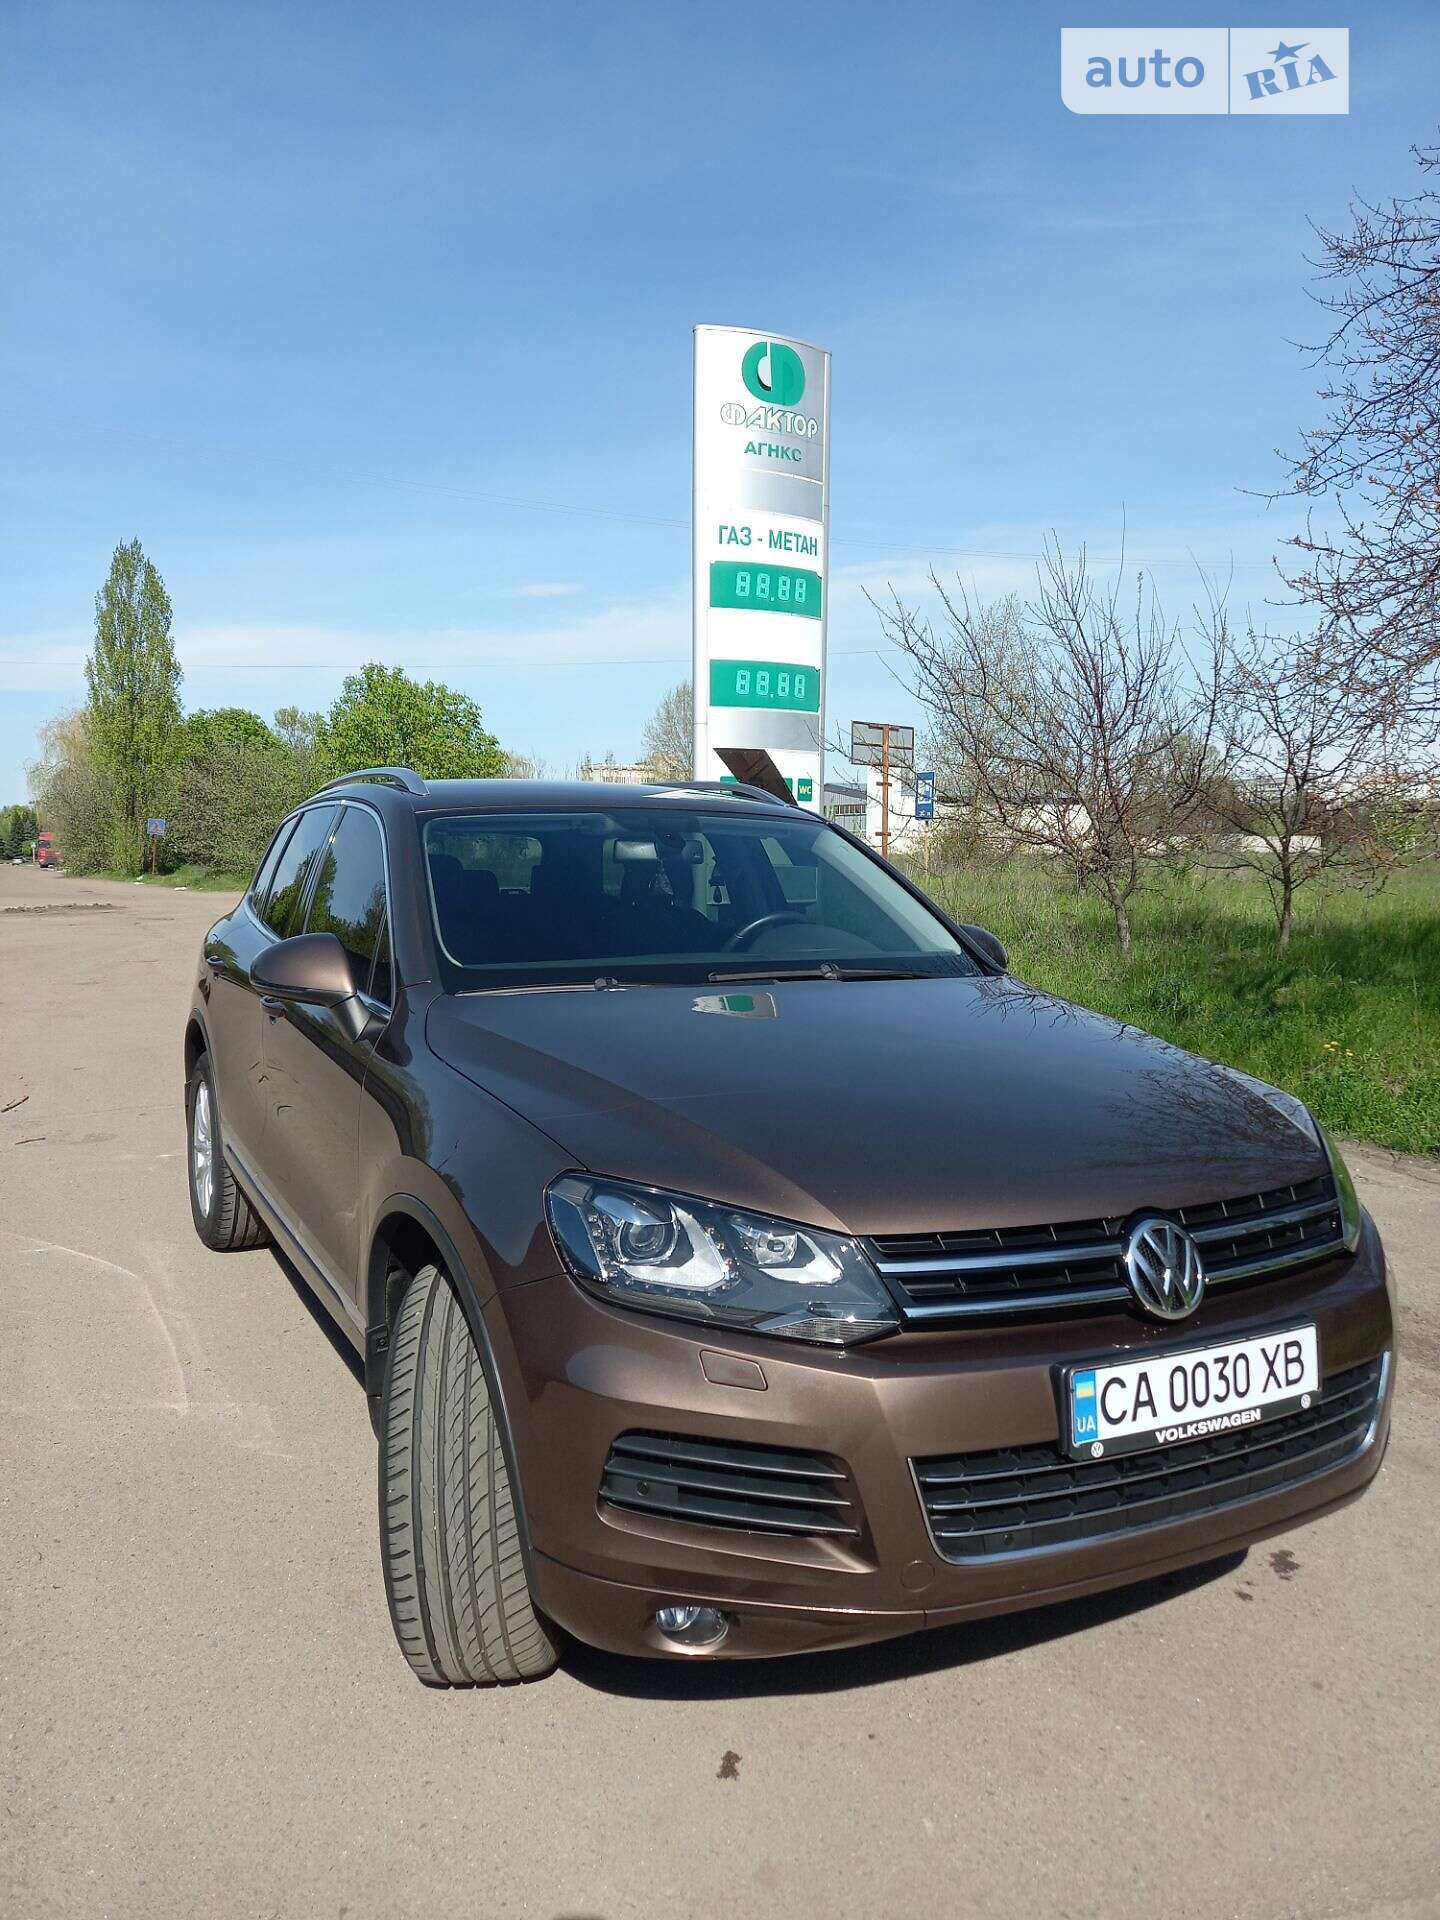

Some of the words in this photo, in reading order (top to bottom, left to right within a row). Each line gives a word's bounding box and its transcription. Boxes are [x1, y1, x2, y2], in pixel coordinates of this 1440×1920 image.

[719, 402, 819, 439] ФАКТОР
[743, 441, 803, 462] АГНКС
[718, 524, 752, 546] ГАЗ
[768, 529, 818, 557] МЕТАН
[735, 571, 807, 603] 88.88
[735, 669, 806, 699] 88.88
[798, 784, 812, 795] WC
[1100, 1371, 1158, 1426] CA
[1169, 1352, 1251, 1413] 0030
[1260, 1340, 1305, 1393] XB
[1076, 1415, 1096, 1433] UA
[1154, 1408, 1262, 1444] VOLKSWAGEN
